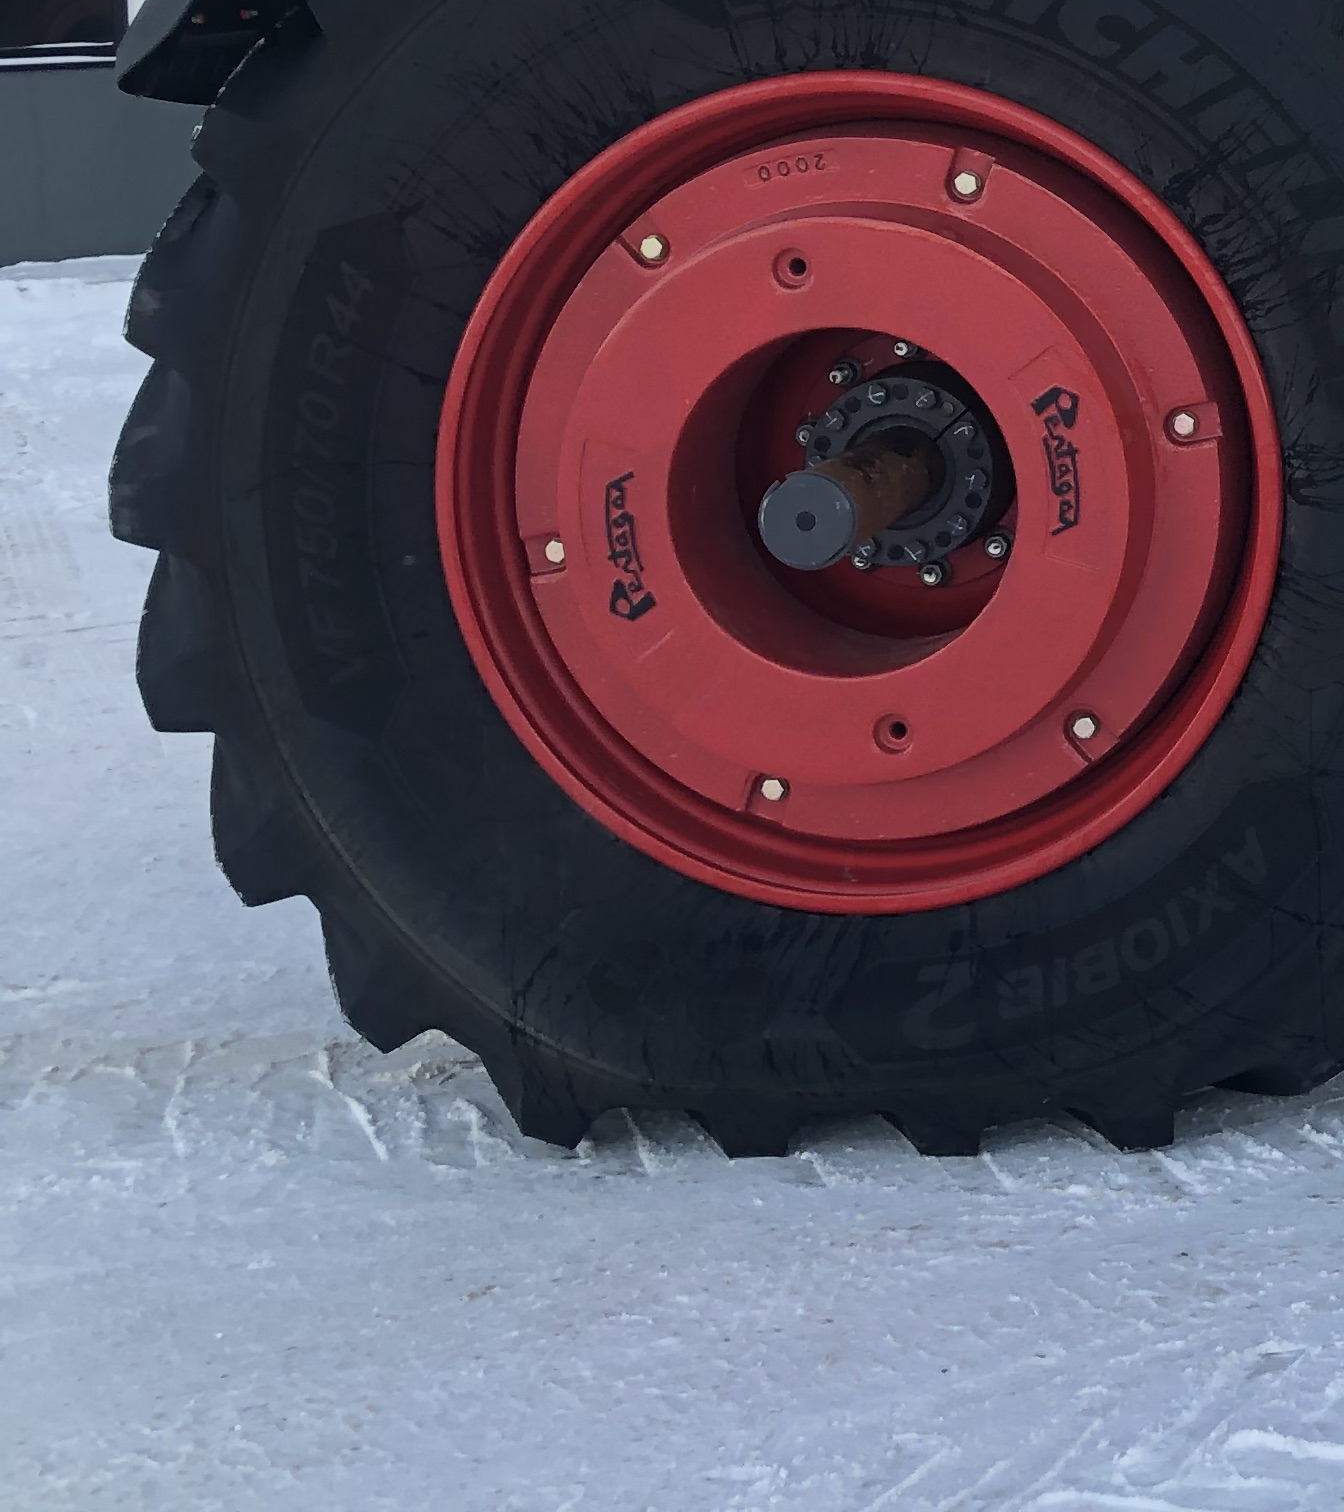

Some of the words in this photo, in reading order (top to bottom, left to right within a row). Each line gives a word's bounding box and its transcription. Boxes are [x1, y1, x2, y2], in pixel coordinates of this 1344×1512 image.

[757, 153, 826, 182] 2000
[1030, 384, 1081, 536] Pentagon
[604, 471, 657, 621] Pentagon
[998, 826, 1268, 1019] AXIOBIB
[904, 961, 977, 1050] 2
